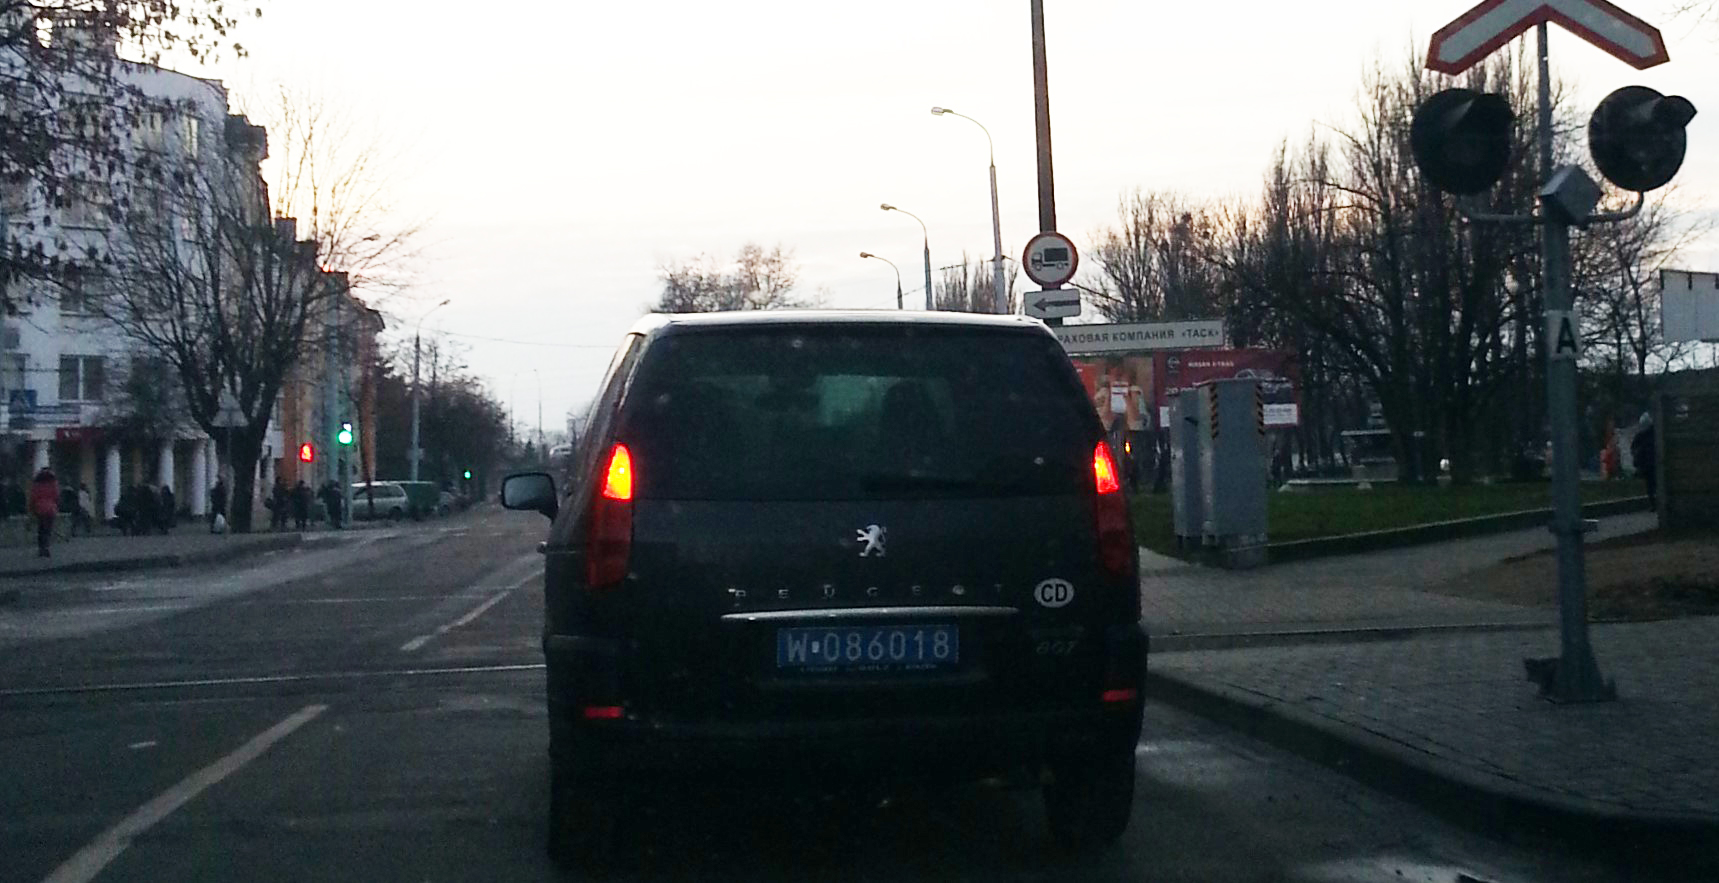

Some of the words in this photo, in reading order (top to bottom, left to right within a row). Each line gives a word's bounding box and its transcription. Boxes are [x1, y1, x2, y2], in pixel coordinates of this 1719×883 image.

[1112, 330, 1174, 342] КОМПАНИЯ
[1182, 328, 1220, 339] «ТАСК»
[1041, 583, 1068, 603] CD
